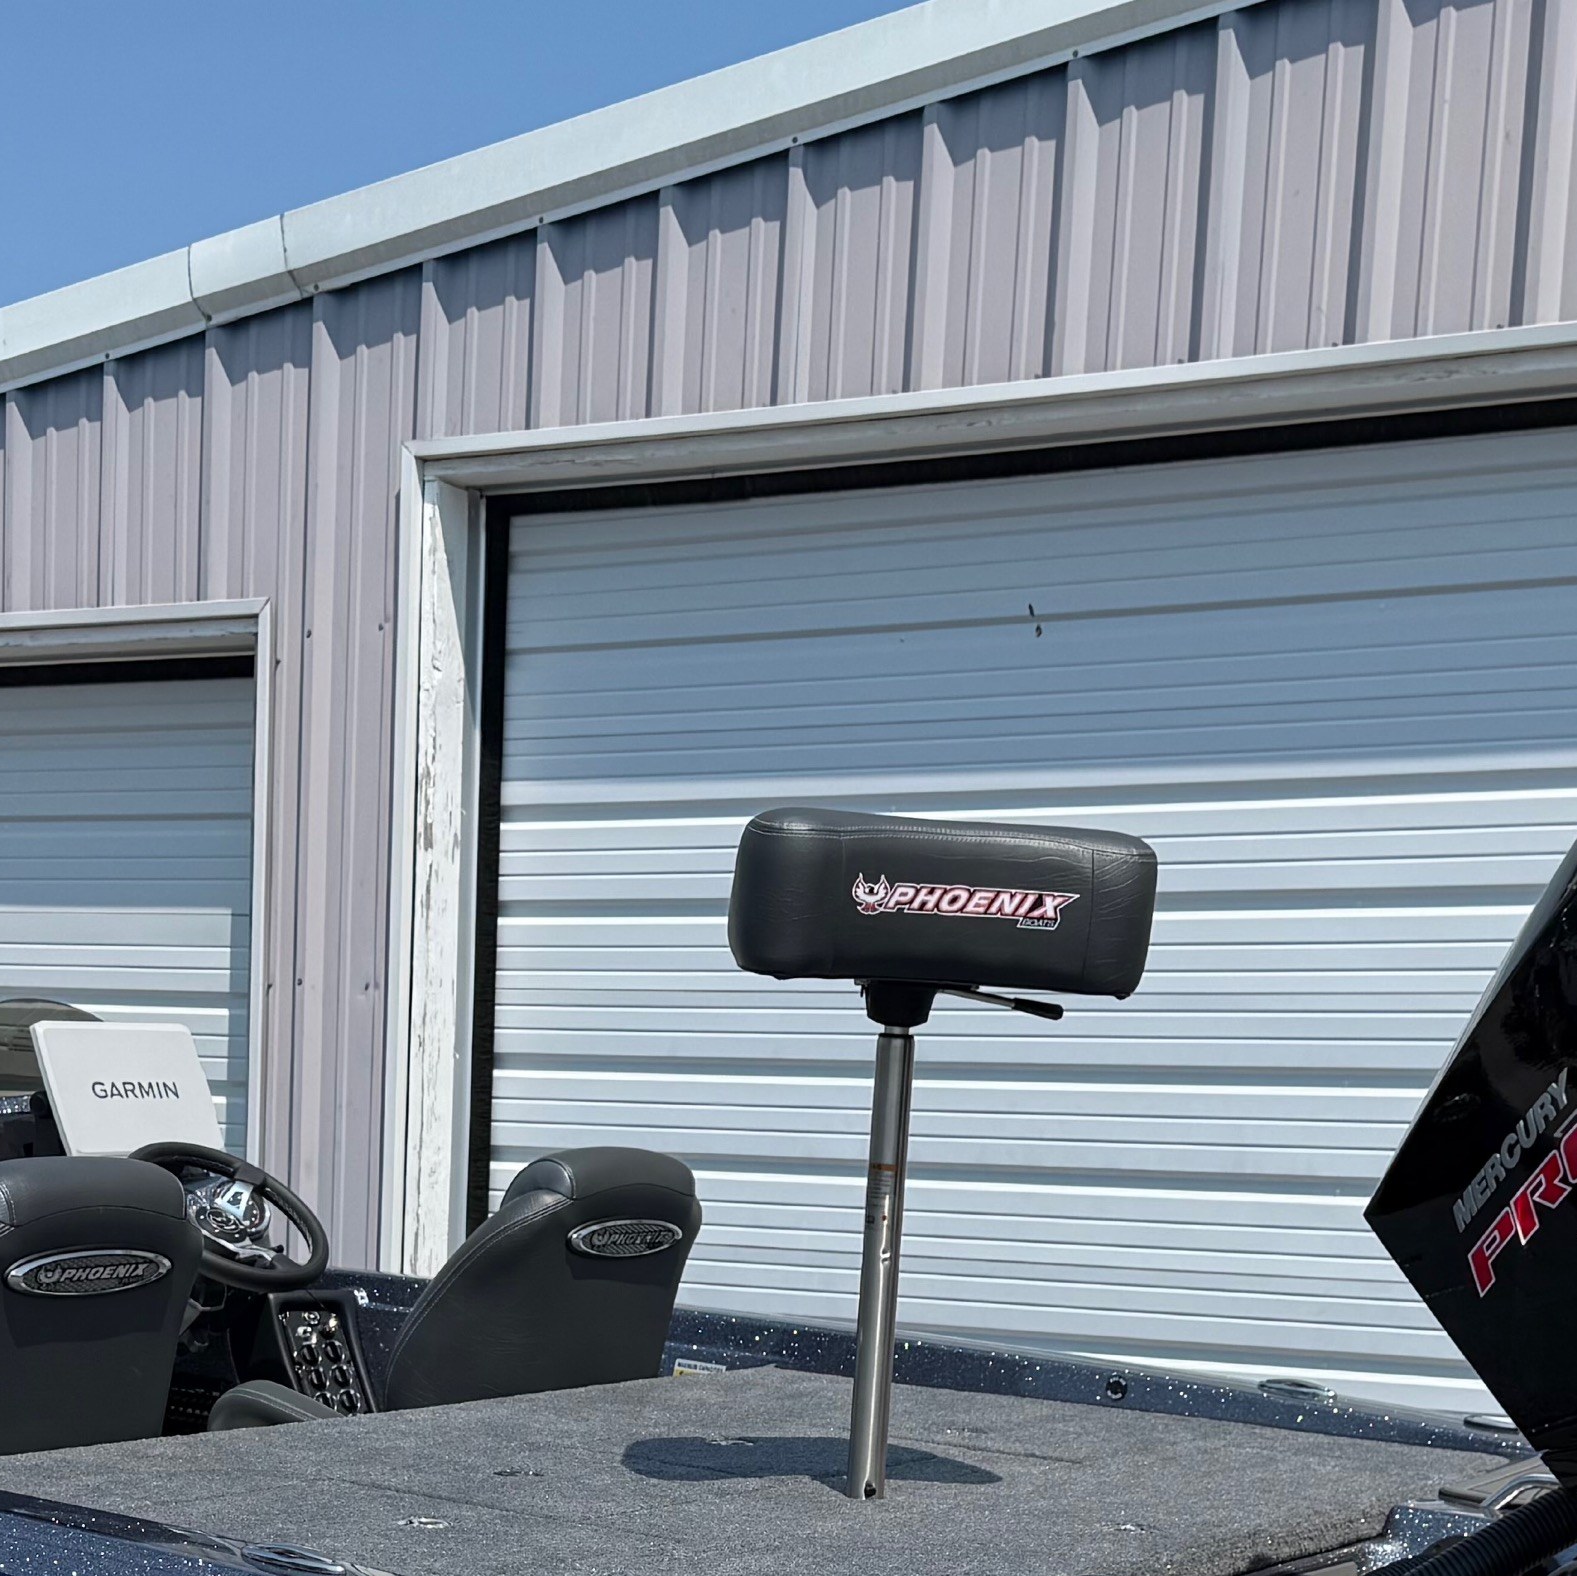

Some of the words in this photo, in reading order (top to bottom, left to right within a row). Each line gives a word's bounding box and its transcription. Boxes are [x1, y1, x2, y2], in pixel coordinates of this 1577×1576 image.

[884, 886, 1069, 919] PHOENIX
[91, 1081, 180, 1099] GARMIN
[1452, 1067, 1568, 1234] MERCURY
[59, 1263, 150, 1282] PHOENIX
